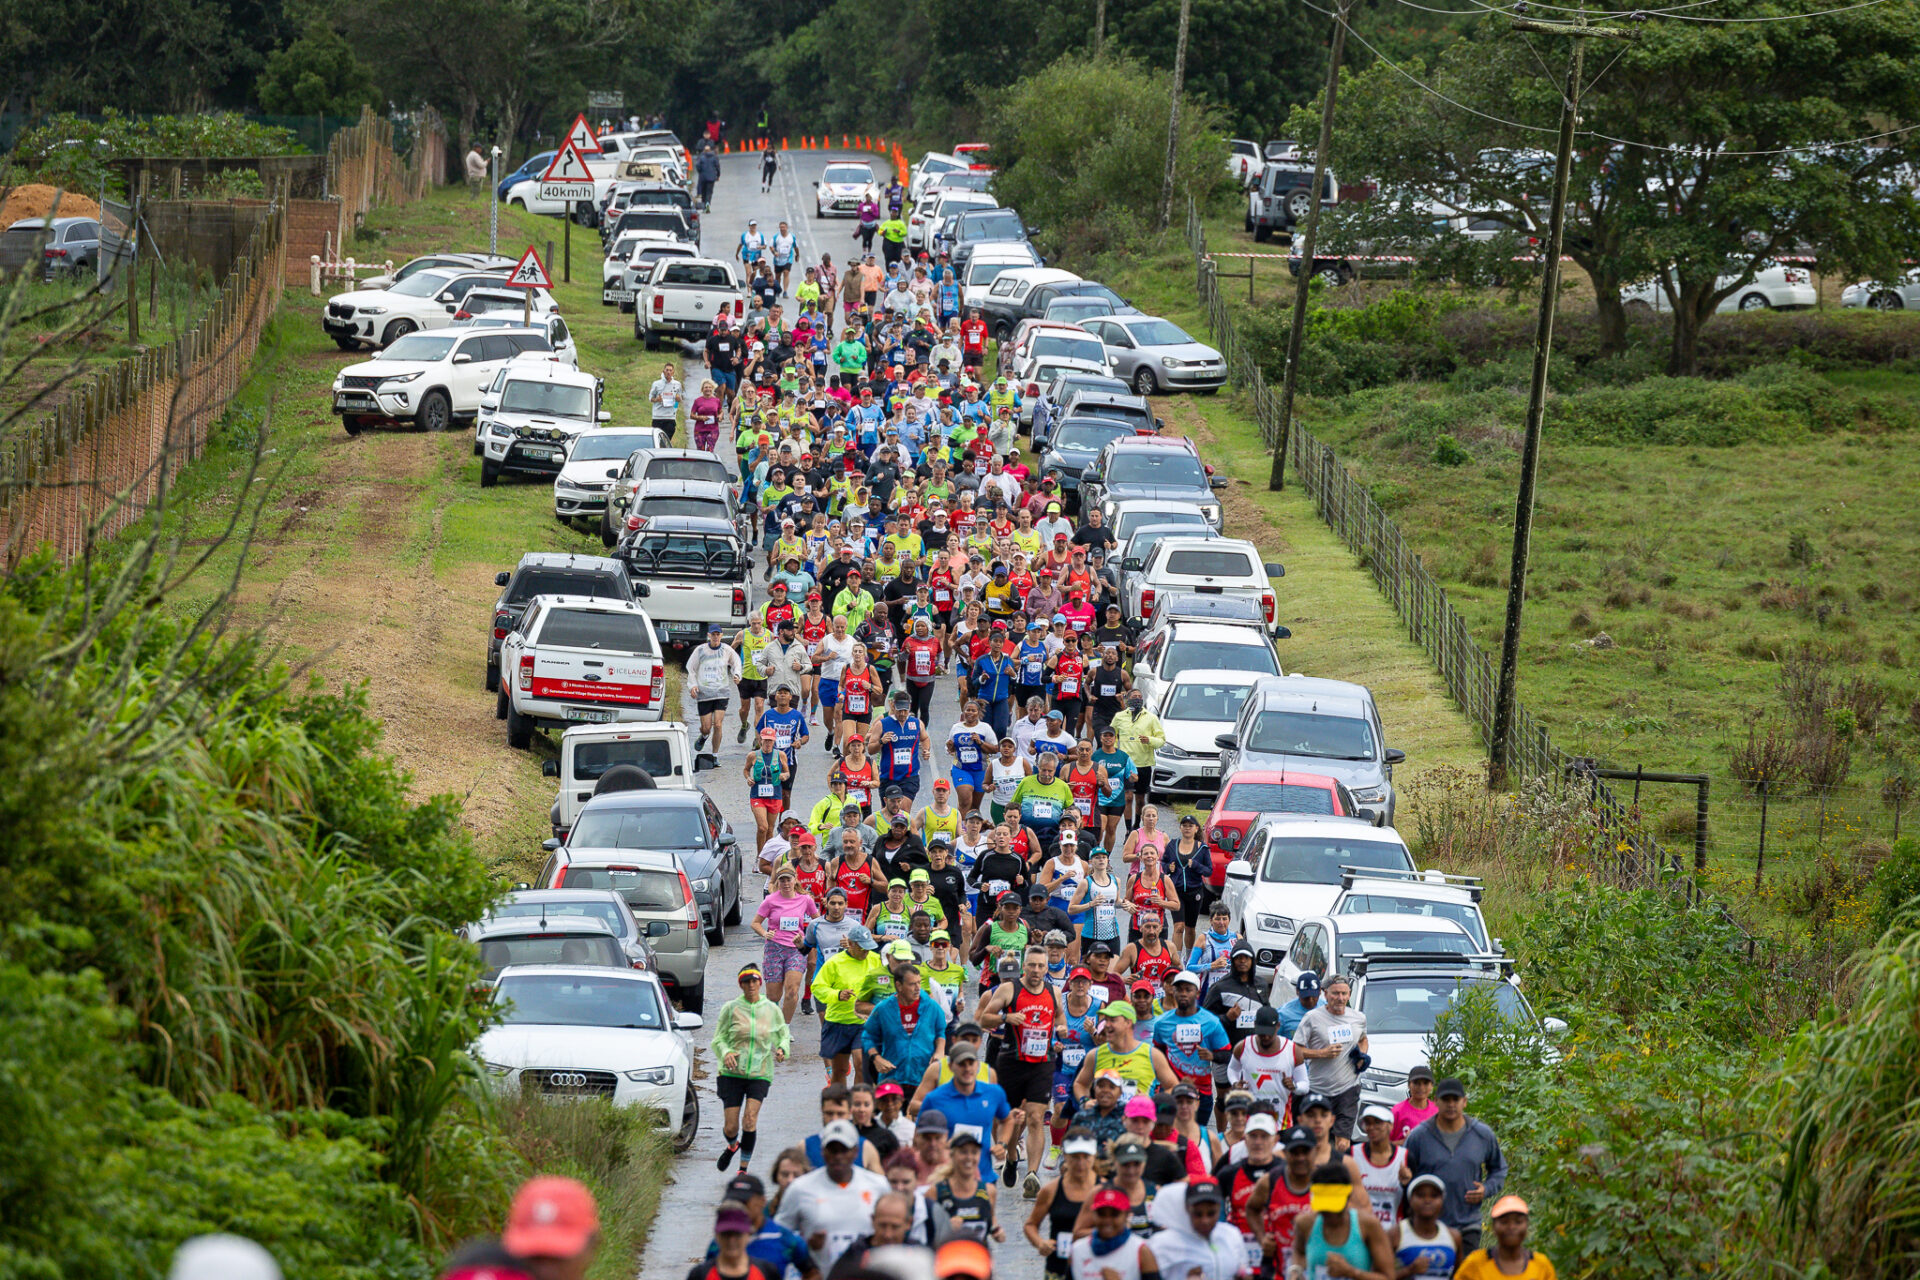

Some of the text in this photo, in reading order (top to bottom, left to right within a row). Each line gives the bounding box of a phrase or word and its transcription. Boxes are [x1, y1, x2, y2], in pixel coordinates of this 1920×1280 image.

[544, 187, 590, 197] 40km/h
[616, 668, 647, 676] ICELAND
[783, 920, 798, 928] 1245
[1019, 1004, 1043, 1014] CHARLO
[1181, 1028, 1200, 1037] 1352
[1332, 1029, 1351, 1038] 1189
